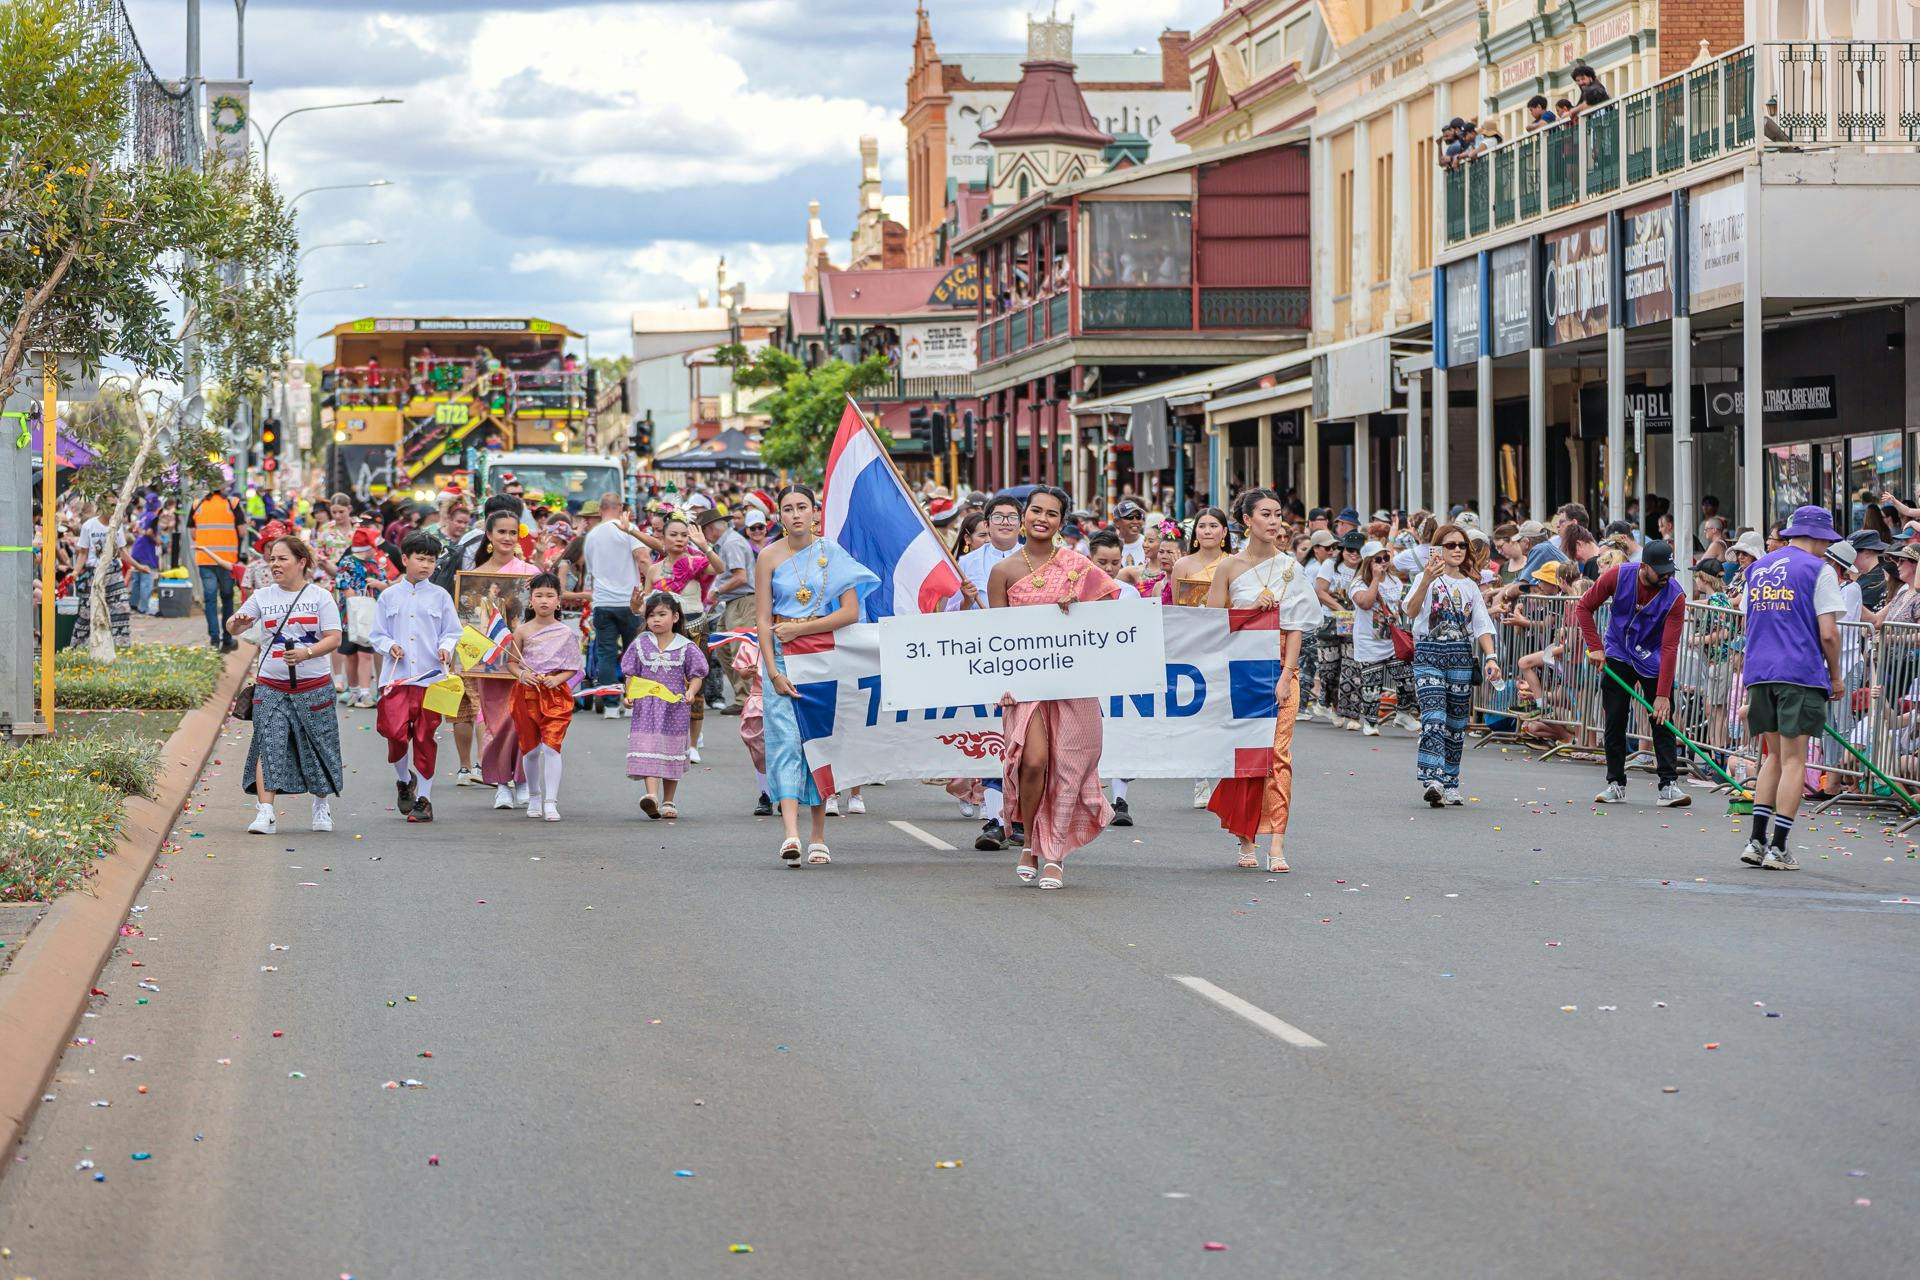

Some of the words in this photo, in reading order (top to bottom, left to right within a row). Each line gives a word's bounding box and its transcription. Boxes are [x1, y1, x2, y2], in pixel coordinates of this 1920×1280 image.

[1590, 13, 1630, 48] BUILDINGS
[420, 320, 465, 330] MINING
[467, 320, 525, 330] SERVICES
[928, 327, 962, 339] CHASE
[923, 339, 945, 351] THE
[947, 338, 968, 350] ACE
[1765, 389, 1791, 407] TRACK
[1792, 386, 1830, 404] BREWERY
[436, 405, 468, 424] 6723
[1750, 588, 1761, 603] St
[1753, 602, 1792, 612] FESTIVAL
[906, 642, 931, 660] 31.
[937, 636, 982, 656] Thai
[988, 630, 1109, 651] Community
[1116, 626, 1137, 644] of
[969, 655, 1075, 677] Kalgoorlie
